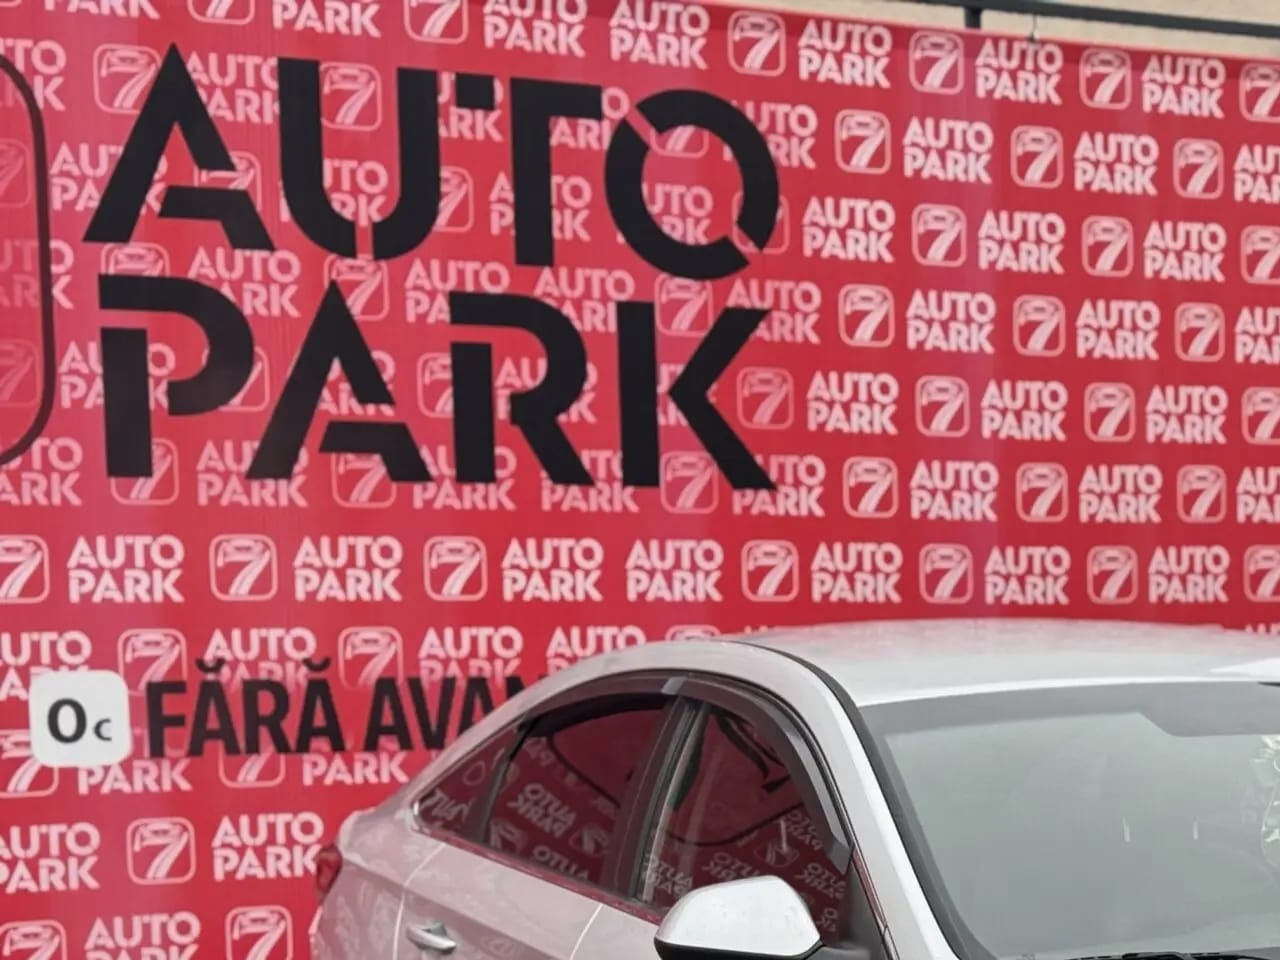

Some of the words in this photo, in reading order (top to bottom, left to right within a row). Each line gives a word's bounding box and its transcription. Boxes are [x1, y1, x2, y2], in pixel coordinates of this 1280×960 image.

[272, 0, 381, 37] PARK
[483, 0, 587, 30] AUTO
[610, 2, 710, 37] AUTO
[485, 24, 584, 57] PARK
[611, 29, 708, 69] PARK
[798, 18, 893, 54] AUTO
[799, 49, 890, 88] PARK
[976, 39, 1064, 71] AUTO
[1142, 55, 1226, 86] AUTO
[976, 68, 1061, 104] PARK
[1143, 83, 1223, 118] PARK
[903, 117, 993, 151] AUTO
[1074, 133, 1159, 164] AUTO
[83, 43, 780, 281] AUTO
[904, 146, 991, 184] PARK
[1075, 161, 1157, 195] PARK
[803, 197, 895, 232] AUTO
[978, 211, 1065, 242] AUTO
[804, 225, 893, 262] PARK
[1144, 221, 1226, 250] AUTO
[187, 247, 300, 284] AUTO
[979, 239, 1063, 274] PARK
[1144, 250, 1224, 282] PARK
[405, 260, 510, 293] AUTO
[534, 267, 634, 300] AUTO
[726, 279, 821, 312] AUTO
[907, 290, 996, 320] AUTO
[1076, 300, 1160, 329] AUTO
[907, 320, 994, 354] PARK
[1077, 329, 1158, 360] PARK
[98, 274, 778, 490] PARK
[808, 372, 898, 405] AUTO
[981, 380, 1067, 412] AUTO
[1146, 386, 1227, 413] AUTO
[808, 400, 897, 434] PARK
[982, 408, 1065, 440] PARK
[1147, 413, 1225, 443] PARK
[910, 460, 998, 492] AUTO
[1079, 465, 1162, 493] AUTO
[911, 488, 996, 521] PARK
[1080, 493, 1160, 522] PARK
[67, 535, 184, 570] AUTO
[293, 536, 402, 568] AUTO
[502, 538, 603, 569] AUTO
[626, 540, 723, 571] AUTO
[811, 543, 902, 572] AUTO
[985, 546, 1070, 576] AUTO
[1149, 546, 1229, 575] AUTO
[69, 569, 184, 603] PARK
[295, 567, 401, 601] PARK
[503, 569, 602, 601] PARK
[627, 570, 721, 601] PARK
[812, 571, 900, 602] PARK
[986, 575, 1068, 604] PARK
[1149, 574, 1227, 602] PARK
[203, 627, 317, 662] AUTO
[418, 626, 524, 658] AUTO
[145, 657, 346, 758] FĂRĂ
[76, 757, 193, 795] PARK
[301, 752, 409, 787] PARK
[212, 812, 324, 848] AUTO
[214, 844, 321, 881] PARK
[85, 912, 200, 950] AUTO
